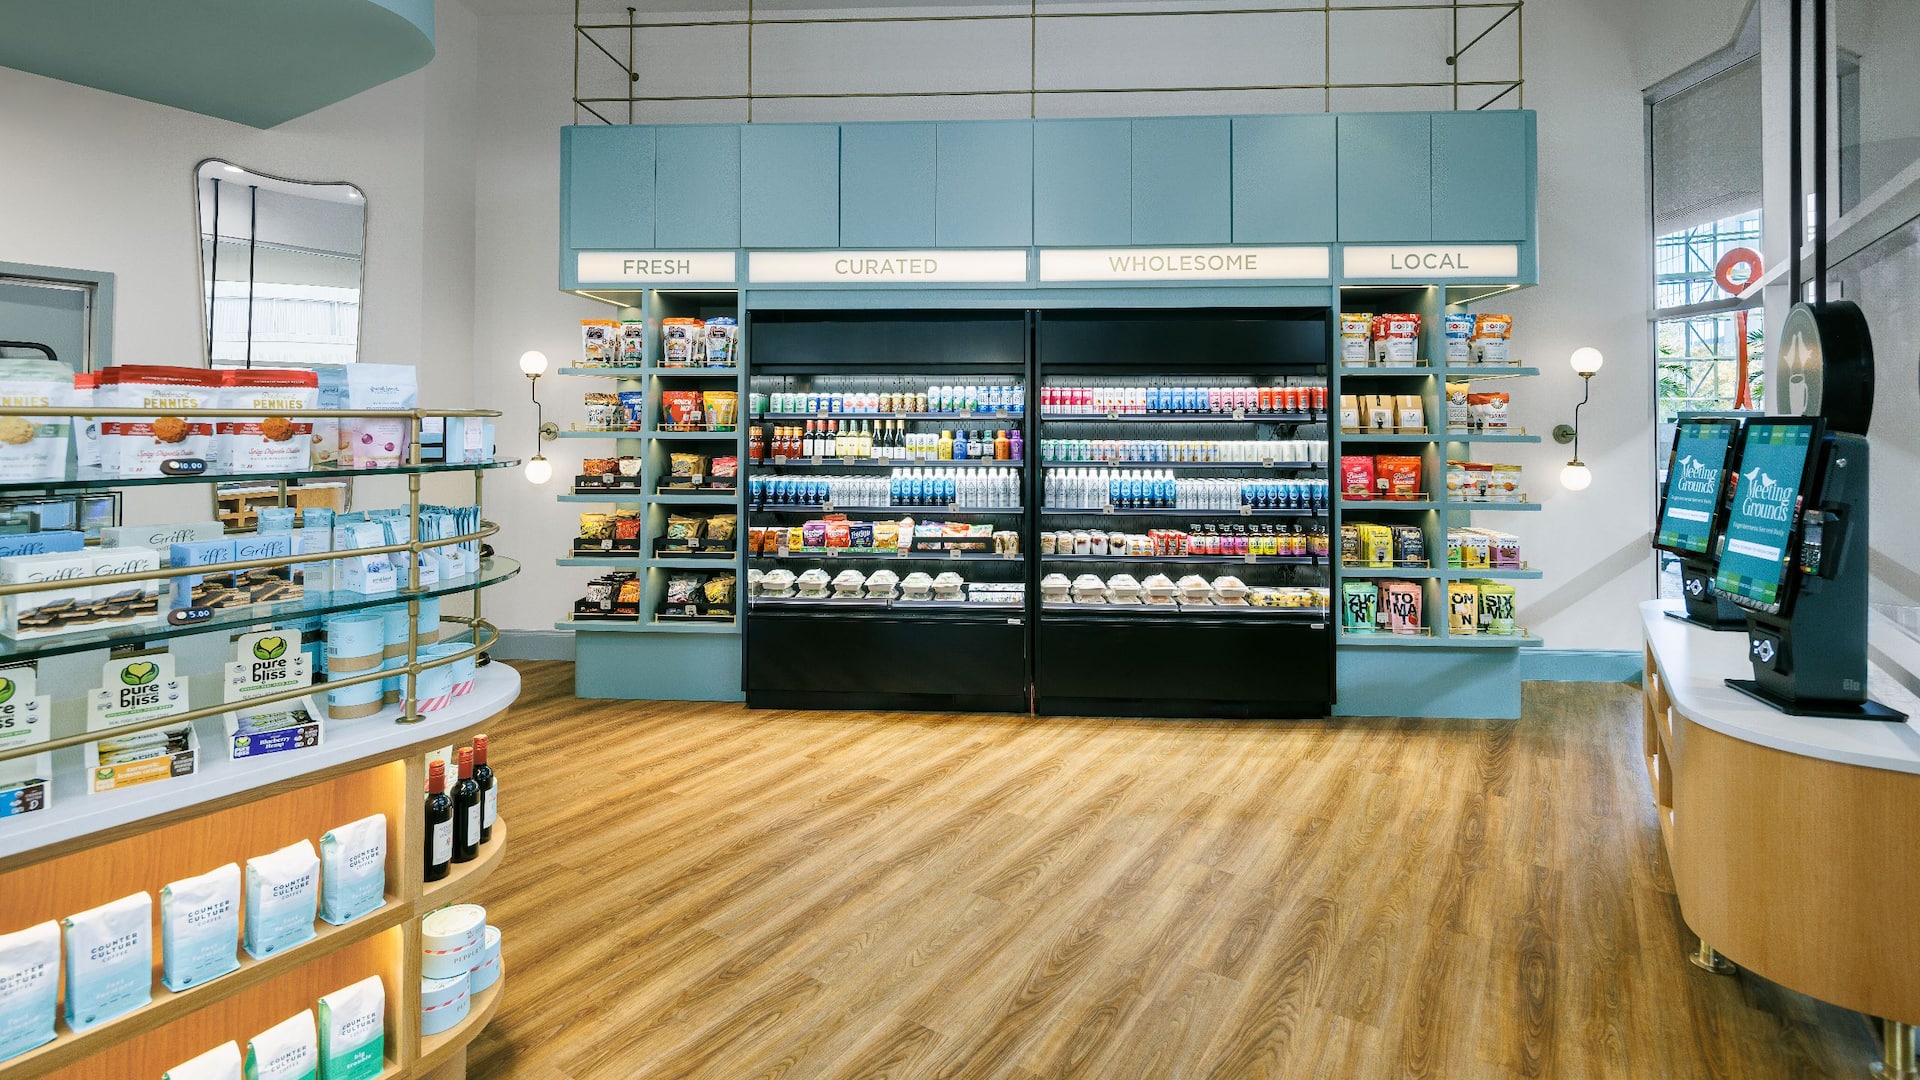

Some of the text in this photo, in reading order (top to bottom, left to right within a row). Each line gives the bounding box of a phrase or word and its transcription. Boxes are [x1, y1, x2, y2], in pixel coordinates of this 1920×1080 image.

[623, 259, 690, 275] FRESH
[834, 258, 938, 275] CURATED
[1108, 254, 1258, 273] WHOLESOME
[1390, 252, 1469, 271] LOCAL
[0, 396, 49, 408] NNIES
[143, 397, 198, 409] PENNIES
[253, 399, 303, 409] PENNIES
[1681, 464, 1718, 483] Meeting
[1678, 477, 1715, 494] Grounds
[1746, 481, 1793, 506] Meeting
[1742, 498, 1789, 521] Grounds
[149, 529, 195, 545] Griff's
[199, 547, 229, 565] riff's
[240, 541, 285, 558] Griff's
[95, 559, 150, 576] Griff's
[1451, 592, 1474, 604] ON
[1485, 594, 1513, 607] SIX
[189, 609, 210, 619] 5.00
[253, 659, 286, 672] pure
[253, 670, 286, 682] bliss
[120, 684, 159, 698] pure
[120, 695, 159, 708] bliss
[350, 846, 379, 862] COUNTER
[350, 851, 380, 867] CULTURE
[273, 875, 310, 891] COUNTER
[273, 880, 309, 897] CULTURE
[188, 900, 230, 917] COUNTER
[188, 906, 230, 923] CULTURE
[91, 932, 138, 954] COUNTER
[91, 939, 138, 960] CULTURE
[0, 963, 44, 983] OUNTER
[0, 971, 44, 990] ULTURE
[342, 1012, 376, 1031] COUNTER
[342, 1017, 376, 1036] CULTURE
[270, 1045, 307, 1066] COUNTER
[271, 1051, 307, 1073] CULTURE
